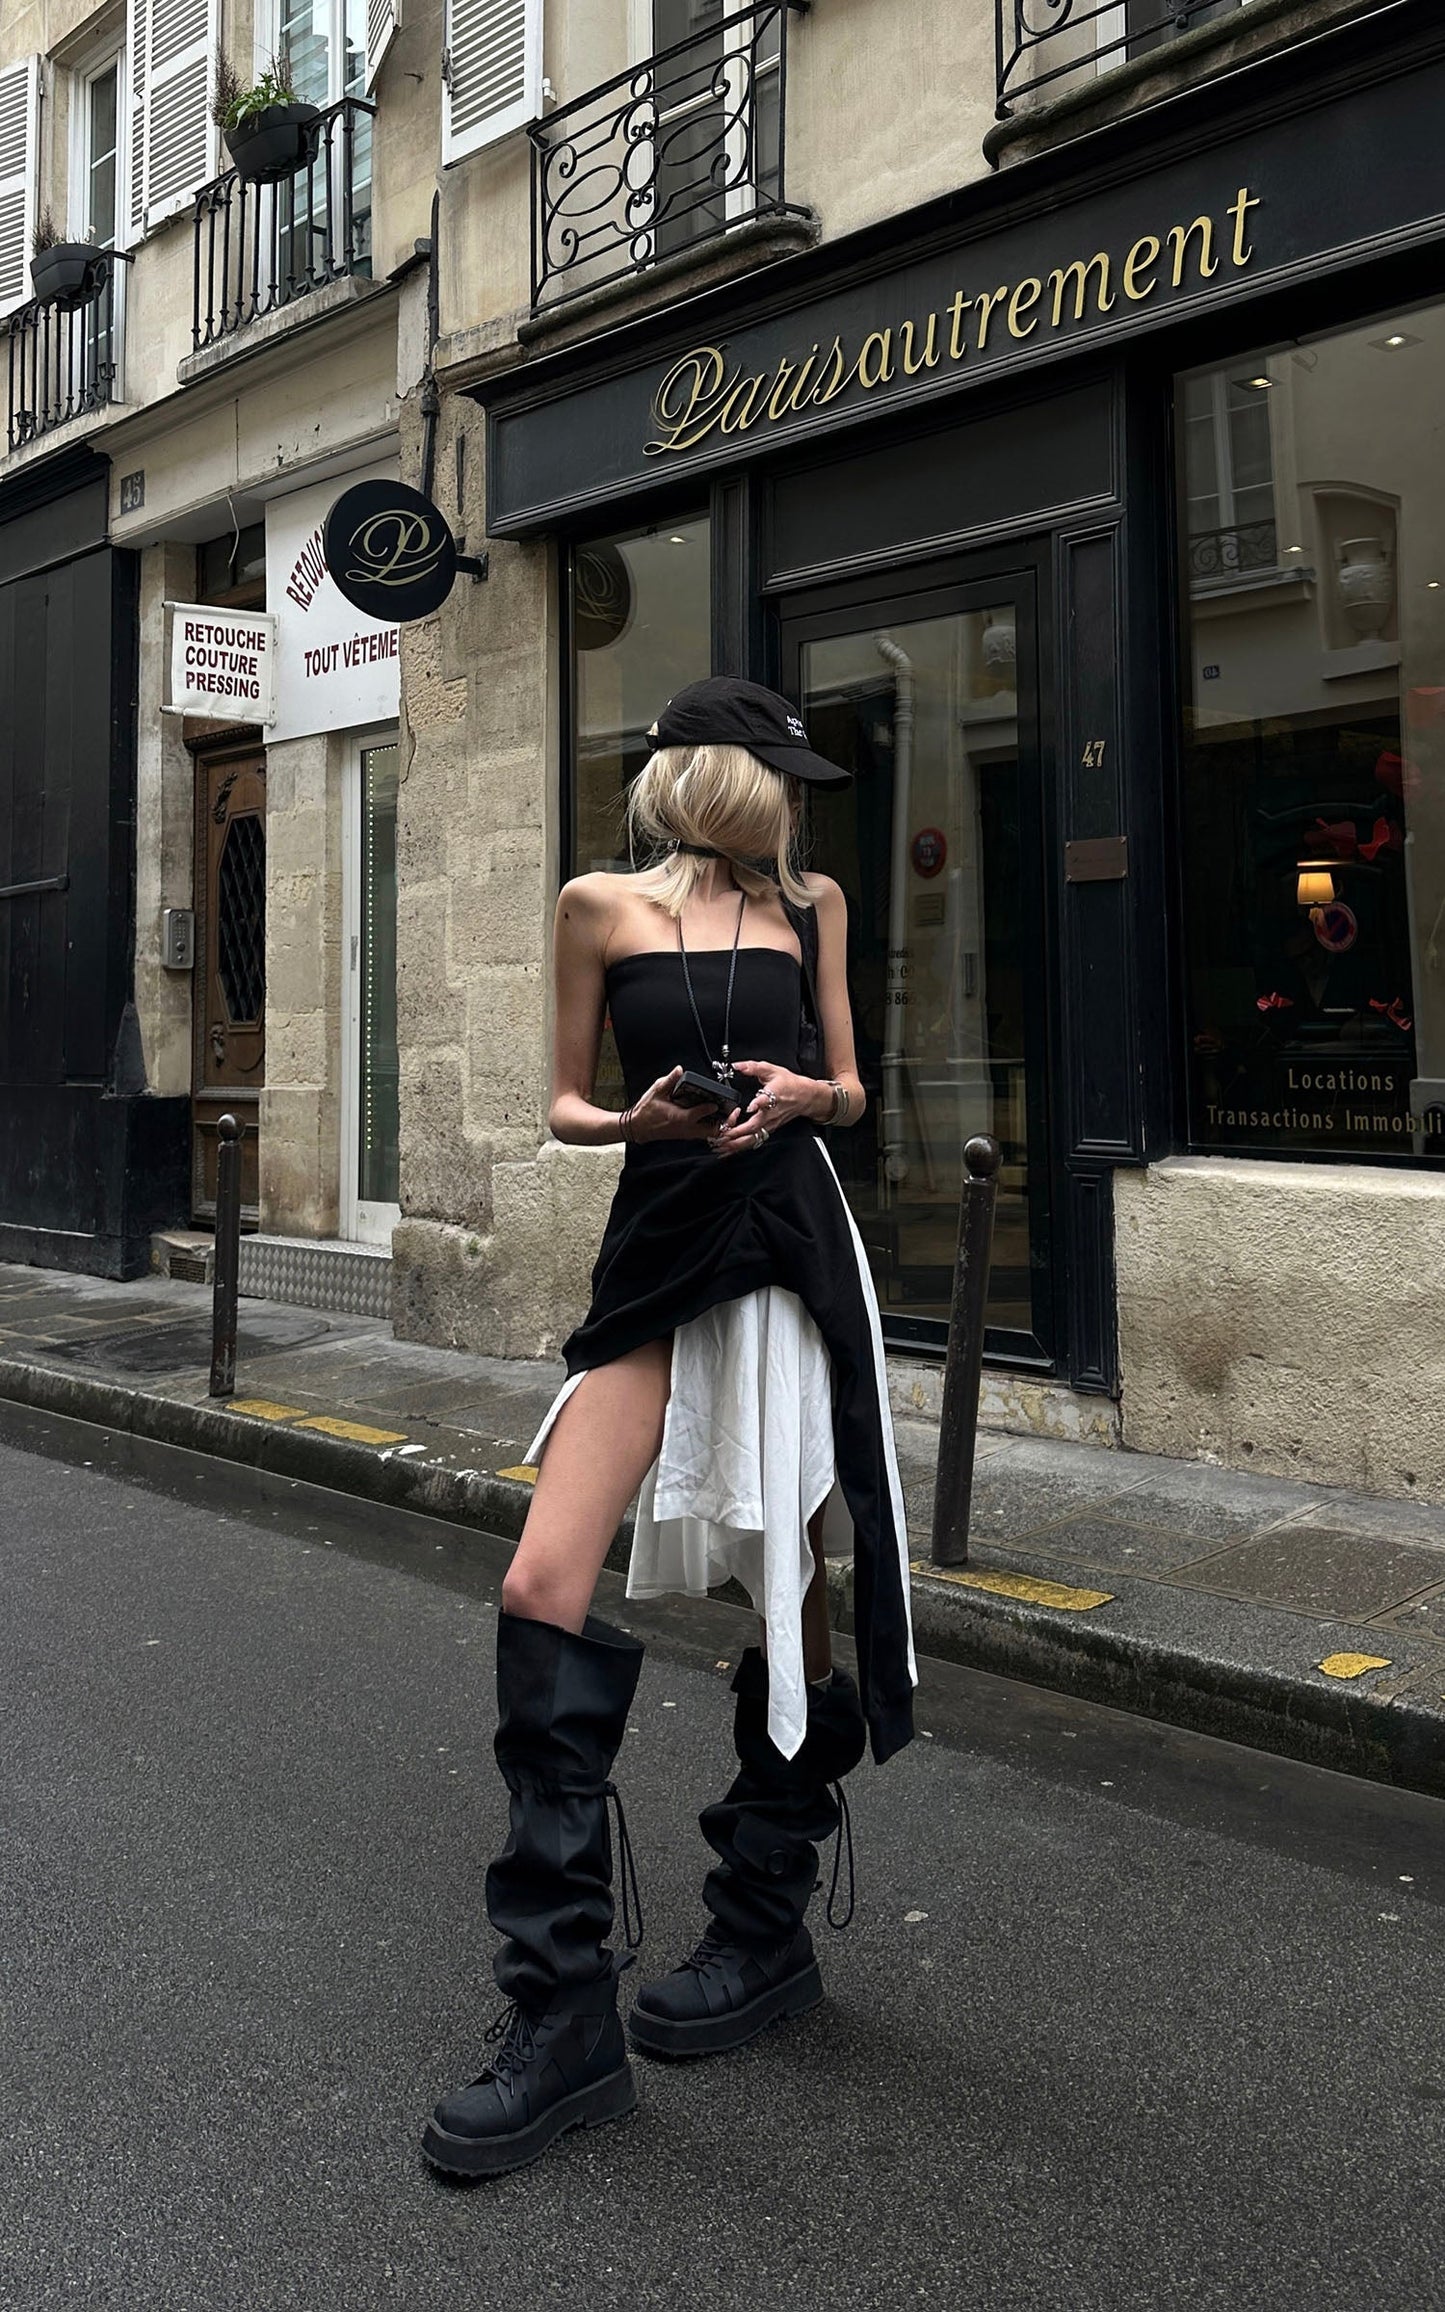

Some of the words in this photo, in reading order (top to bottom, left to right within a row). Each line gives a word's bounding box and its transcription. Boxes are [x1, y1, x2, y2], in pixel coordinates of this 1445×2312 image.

[642, 187, 1261, 457] Parisautrement
[122, 476, 141, 509] 45
[286, 526, 328, 611] RETOUC
[184, 621, 266, 652] RETOUCHE
[185, 645, 258, 677] COUTURE
[304, 644, 339, 678] TOUT
[343, 629, 401, 668] VÊTEME
[185, 670, 260, 700] PRESSING
[1081, 740, 1106, 768] 47
[1287, 1067, 1395, 1092] Locations
[1206, 1104, 1335, 1131] Transactions
[1345, 1108, 1443, 1136] Immobili
